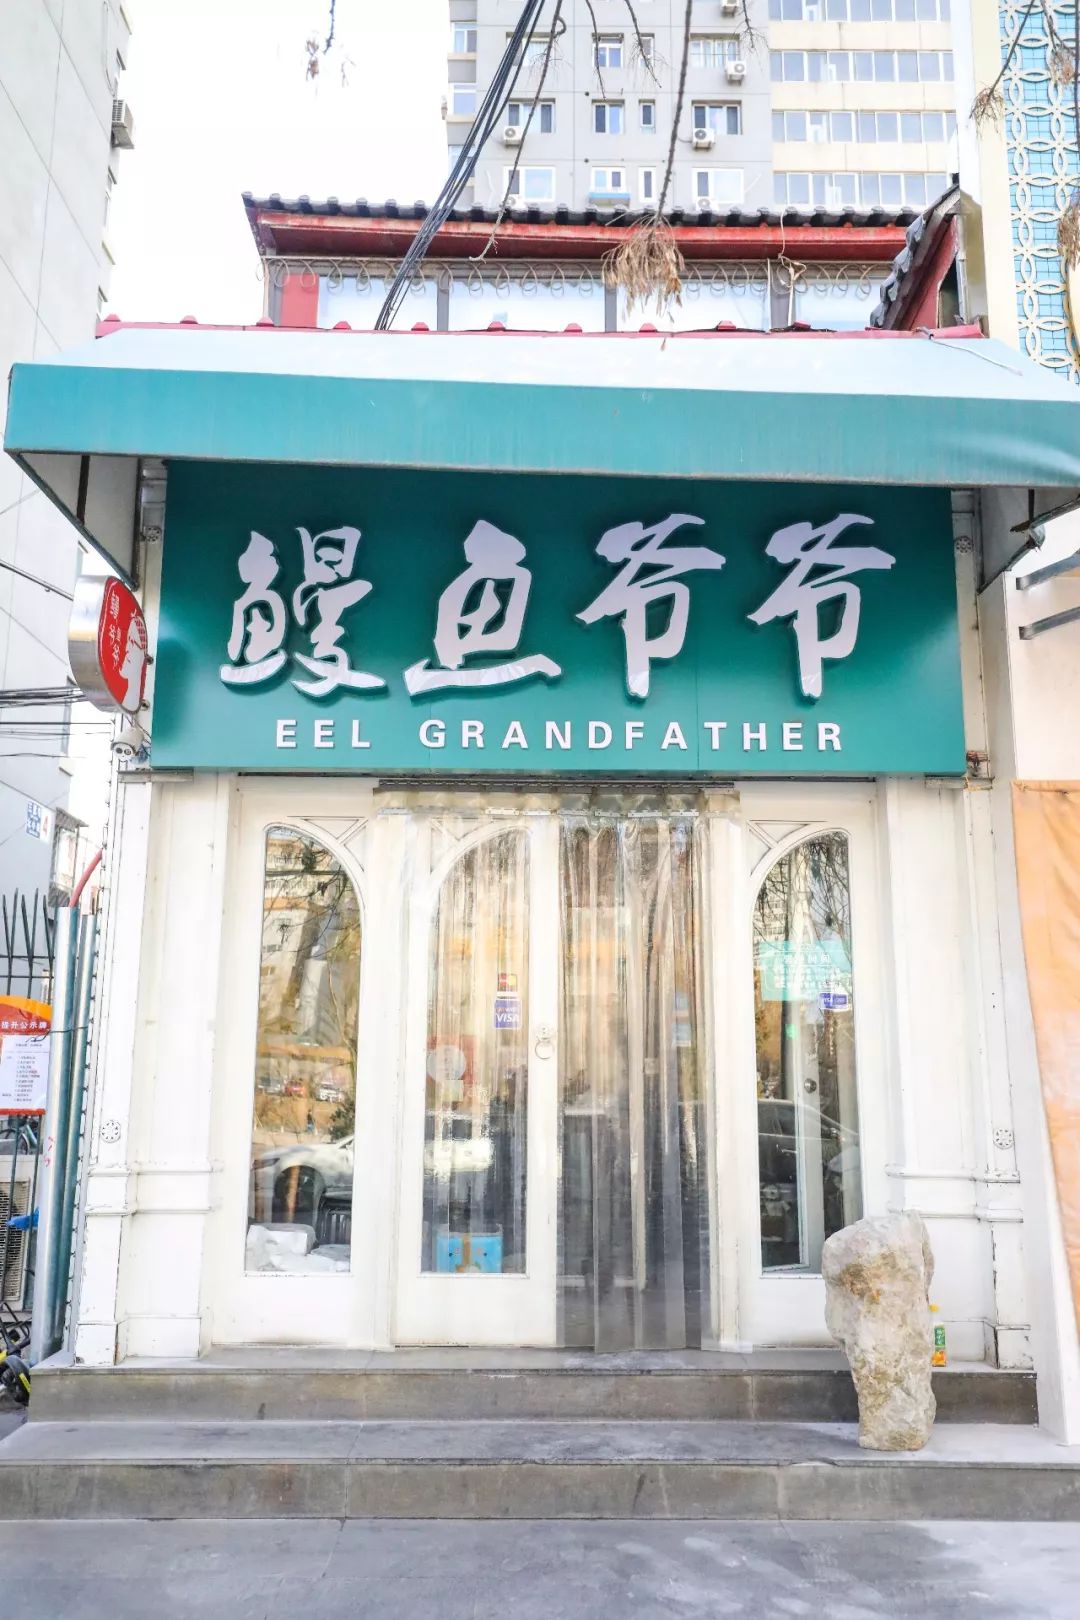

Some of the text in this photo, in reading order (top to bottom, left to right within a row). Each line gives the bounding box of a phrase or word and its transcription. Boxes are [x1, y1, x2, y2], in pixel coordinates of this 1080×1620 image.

[219, 513, 895, 699] 鳗鱼爷爷
[275, 719, 842, 751] EEL GRANDFATHER
[496, 1013, 520, 1023] VISA
